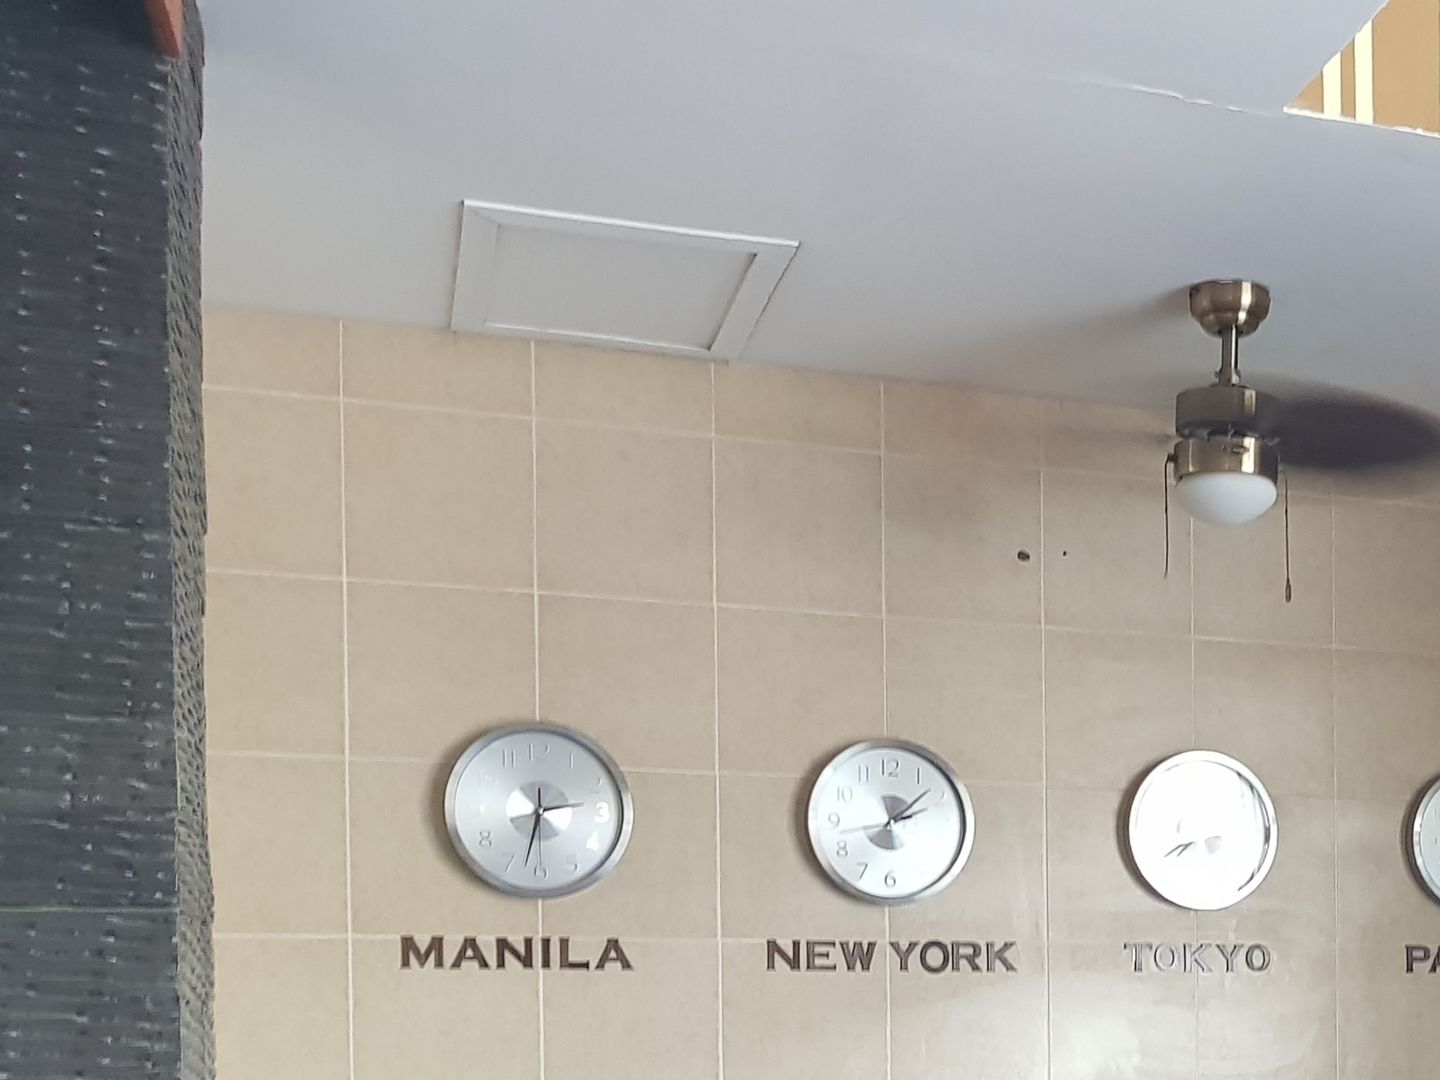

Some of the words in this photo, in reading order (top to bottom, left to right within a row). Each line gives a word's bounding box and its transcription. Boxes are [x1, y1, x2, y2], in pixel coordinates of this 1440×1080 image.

[858, 764, 870, 782] 11
[881, 757, 900, 777] 12
[916, 767, 920, 785] 1
[836, 785, 853, 802] 10
[594, 802, 610, 824] 3
[828, 812, 840, 829] 9
[478, 831, 492, 848] 8
[836, 839, 848, 857] 8
[857, 862, 868, 881] 7
[884, 870, 897, 888] 6
[399, 935, 634, 971] MANILA
[766, 938, 877, 972] NEW
[889, 940, 1018, 974] YORK
[1123, 942, 1272, 974] TOKYO
